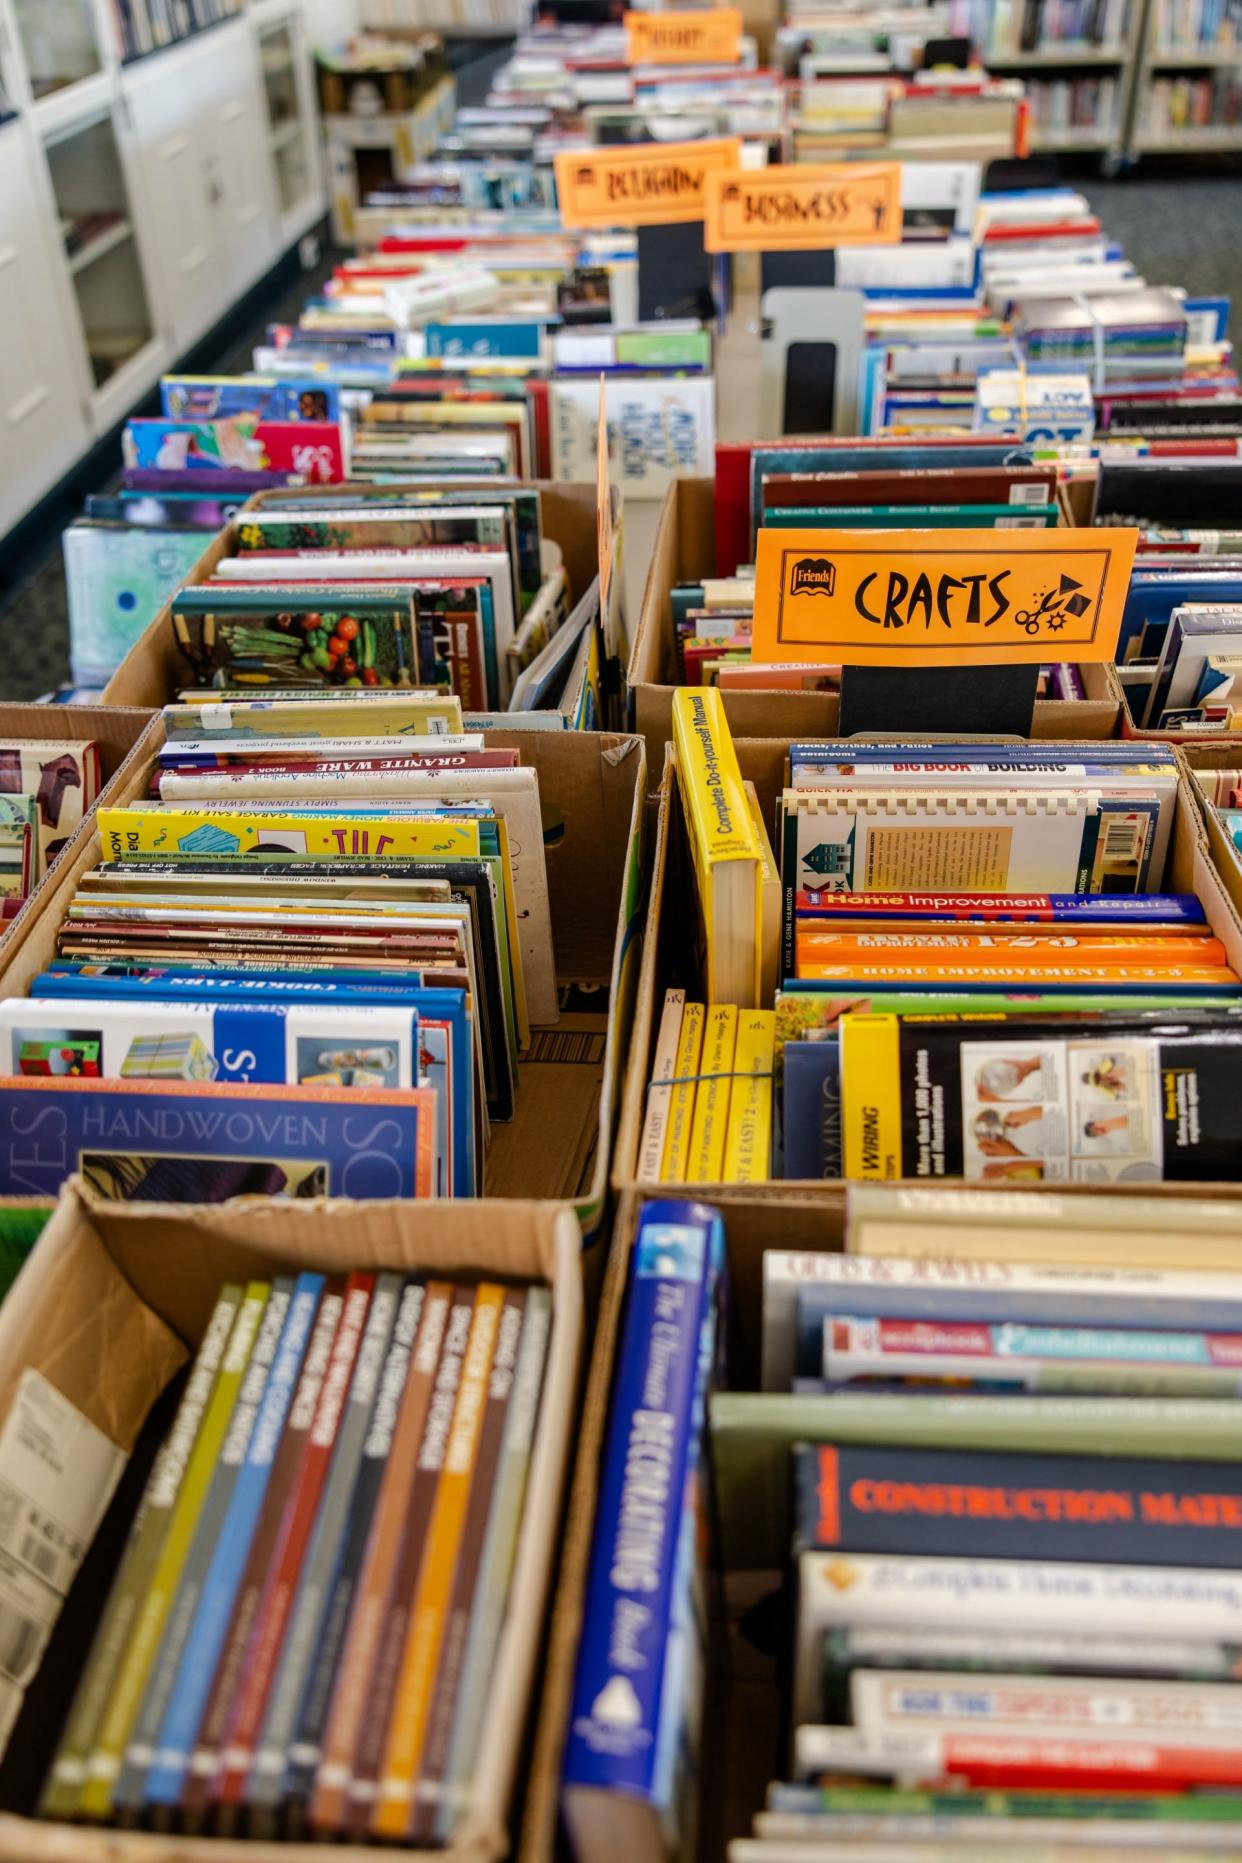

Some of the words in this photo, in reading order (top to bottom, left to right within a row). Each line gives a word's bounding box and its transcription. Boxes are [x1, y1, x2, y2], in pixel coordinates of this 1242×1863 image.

[797, 568, 830, 583] Friends
[854, 570, 1012, 629] CRAFTS
[688, 696, 707, 727] Manual
[316, 761, 371, 772] WARE
[380, 757, 466, 769] GRANITE
[204, 799, 248, 808] JEWELRY
[250, 799, 300, 808] STUNNING
[303, 799, 339, 808] SIMPLY
[181, 809, 201, 817] KIT
[204, 809, 233, 818] SALE
[236, 810, 289, 820] GARAGE
[711, 786, 733, 835] Complete
[826, 894, 904, 906] Home
[908, 895, 1047, 909] Improvement
[1055, 899, 1089, 909] and
[1099, 899, 1161, 911] Repair
[863, 967, 929, 976] HOME
[937, 967, 1107, 978] IMPROVEMENT
[1119, 968, 1183, 977] 1-2-3
[239, 981, 337, 992] COOKIE
[81, 1108, 327, 1146] HANDWOVEN
[861, 1105, 880, 1170] WIRING
[610, 1408, 675, 1592] DECORATING
[849, 1477, 1132, 1524] CONSTRUCTION
